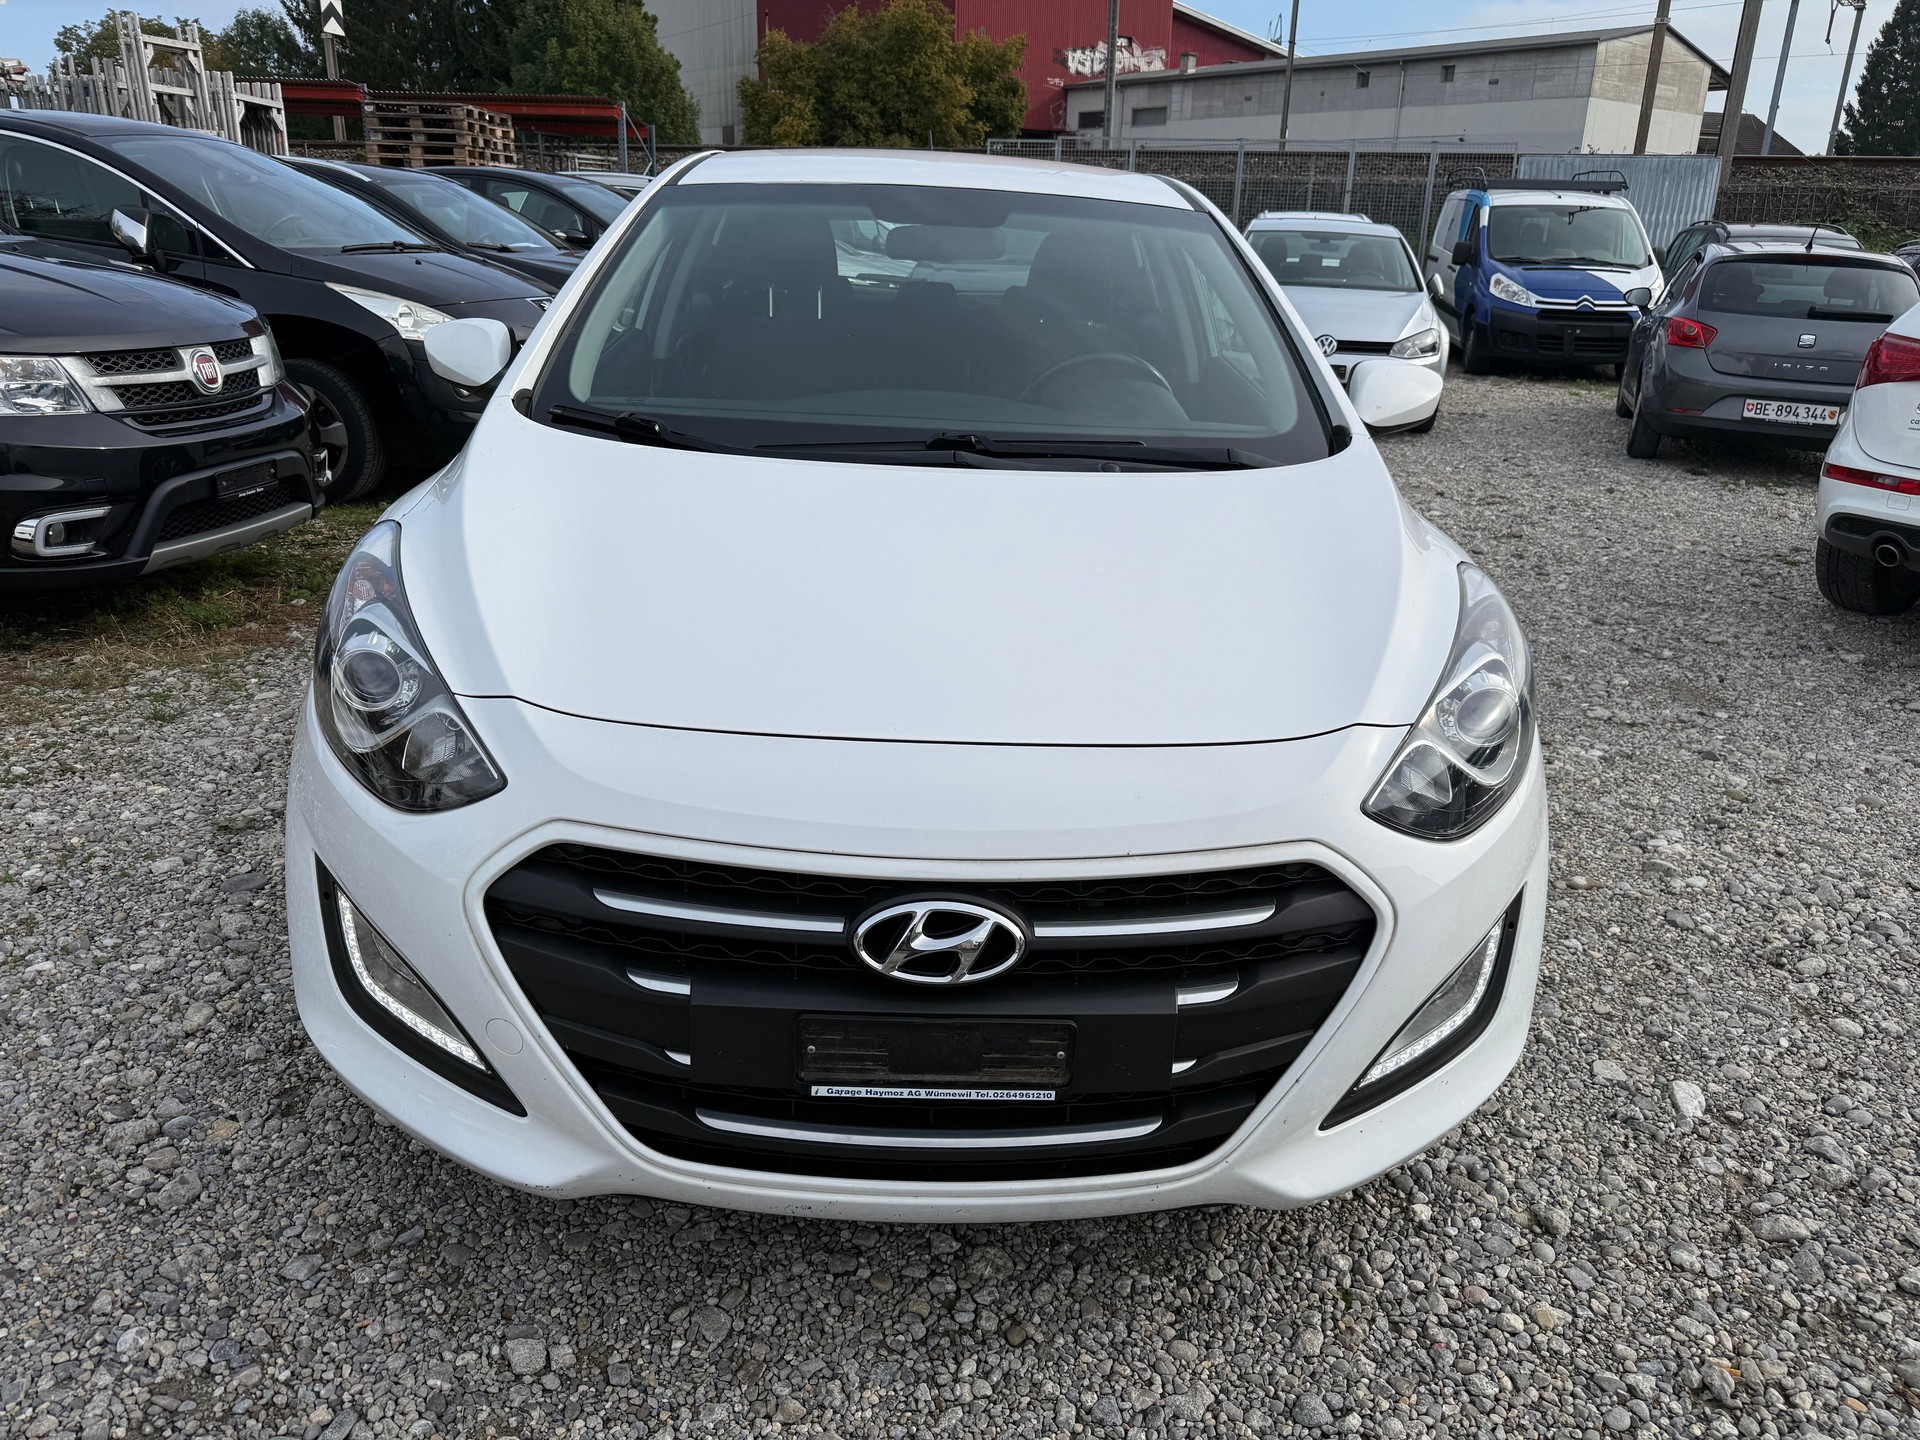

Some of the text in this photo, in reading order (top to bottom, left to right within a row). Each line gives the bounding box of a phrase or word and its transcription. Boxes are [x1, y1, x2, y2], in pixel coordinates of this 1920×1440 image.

[199, 362, 217, 380] FIAT
[826, 1088, 862, 1097] Garage
[865, 1088, 905, 1098] Haymoz
[907, 1089, 922, 1097] AG
[924, 1090, 972, 1098] Wünnewil
